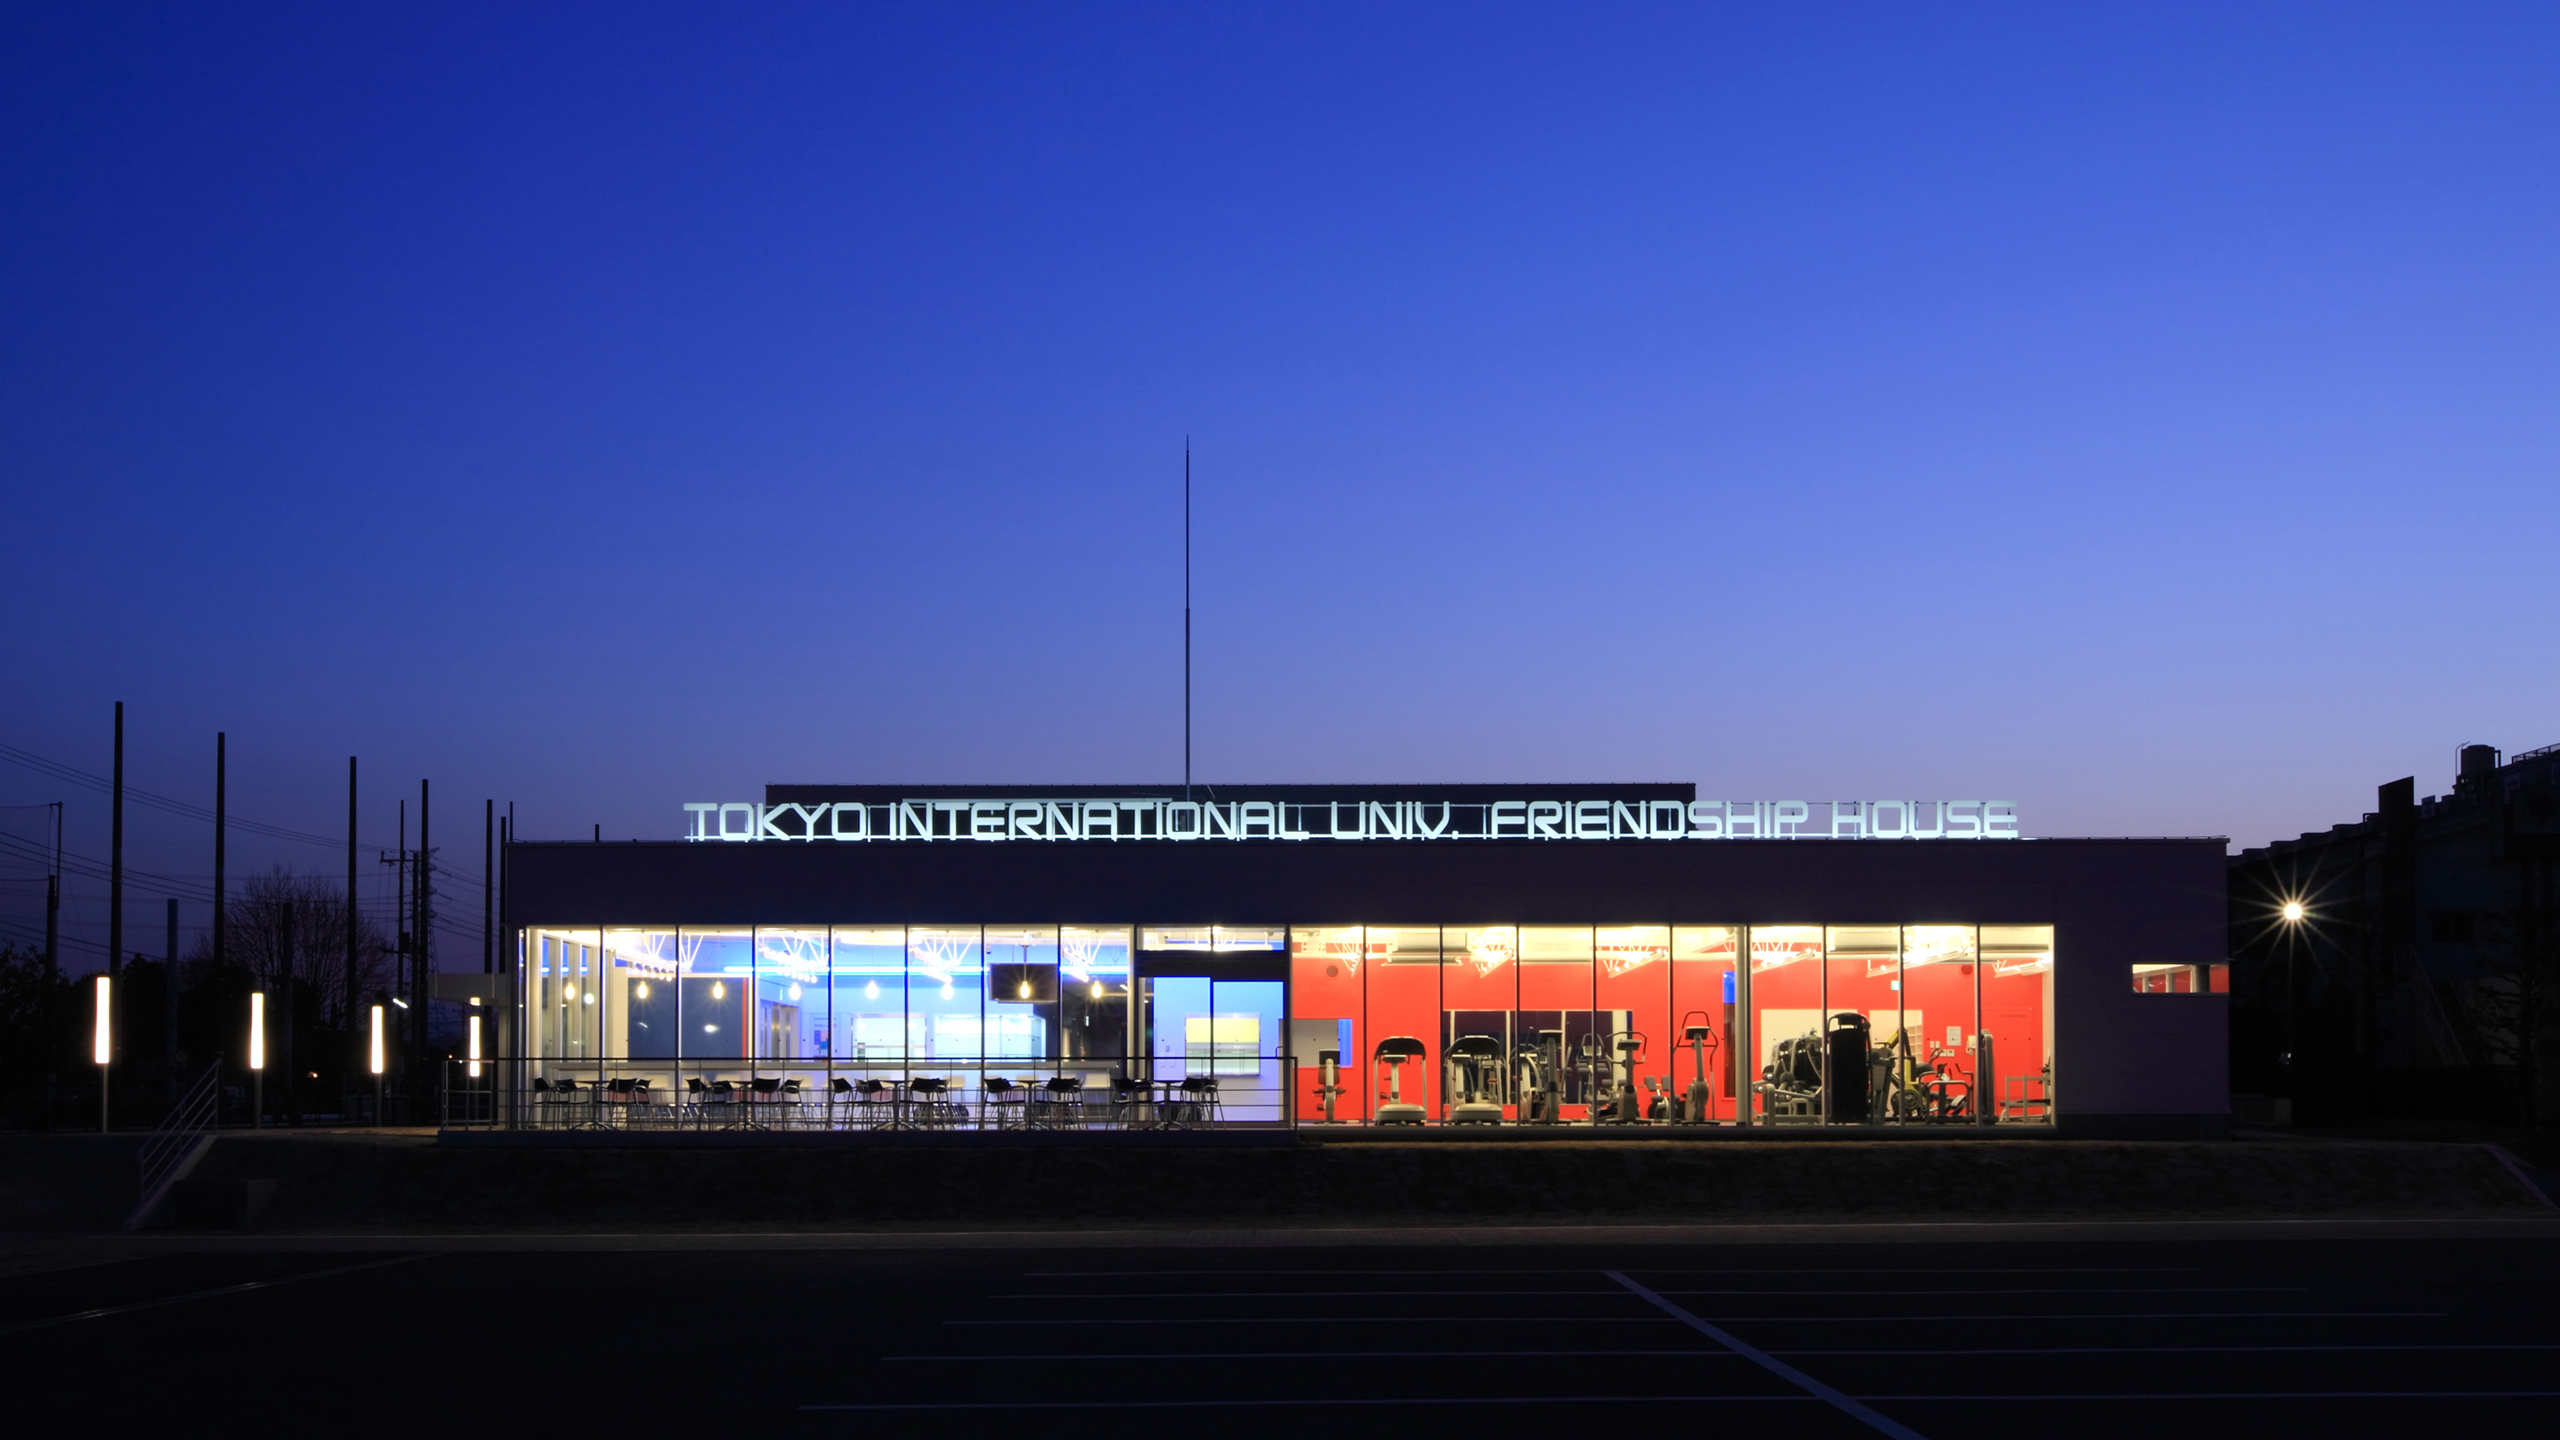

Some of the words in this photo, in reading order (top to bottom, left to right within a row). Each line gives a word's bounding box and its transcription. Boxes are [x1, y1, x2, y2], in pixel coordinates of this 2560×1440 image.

[684, 803, 867, 841] TOKYO
[889, 801, 1309, 840] INTERNATIONAL
[1331, 801, 1459, 839] UNIV.
[1491, 801, 1809, 839] FRIENDSHIP
[1832, 800, 2019, 838] HOUSE
